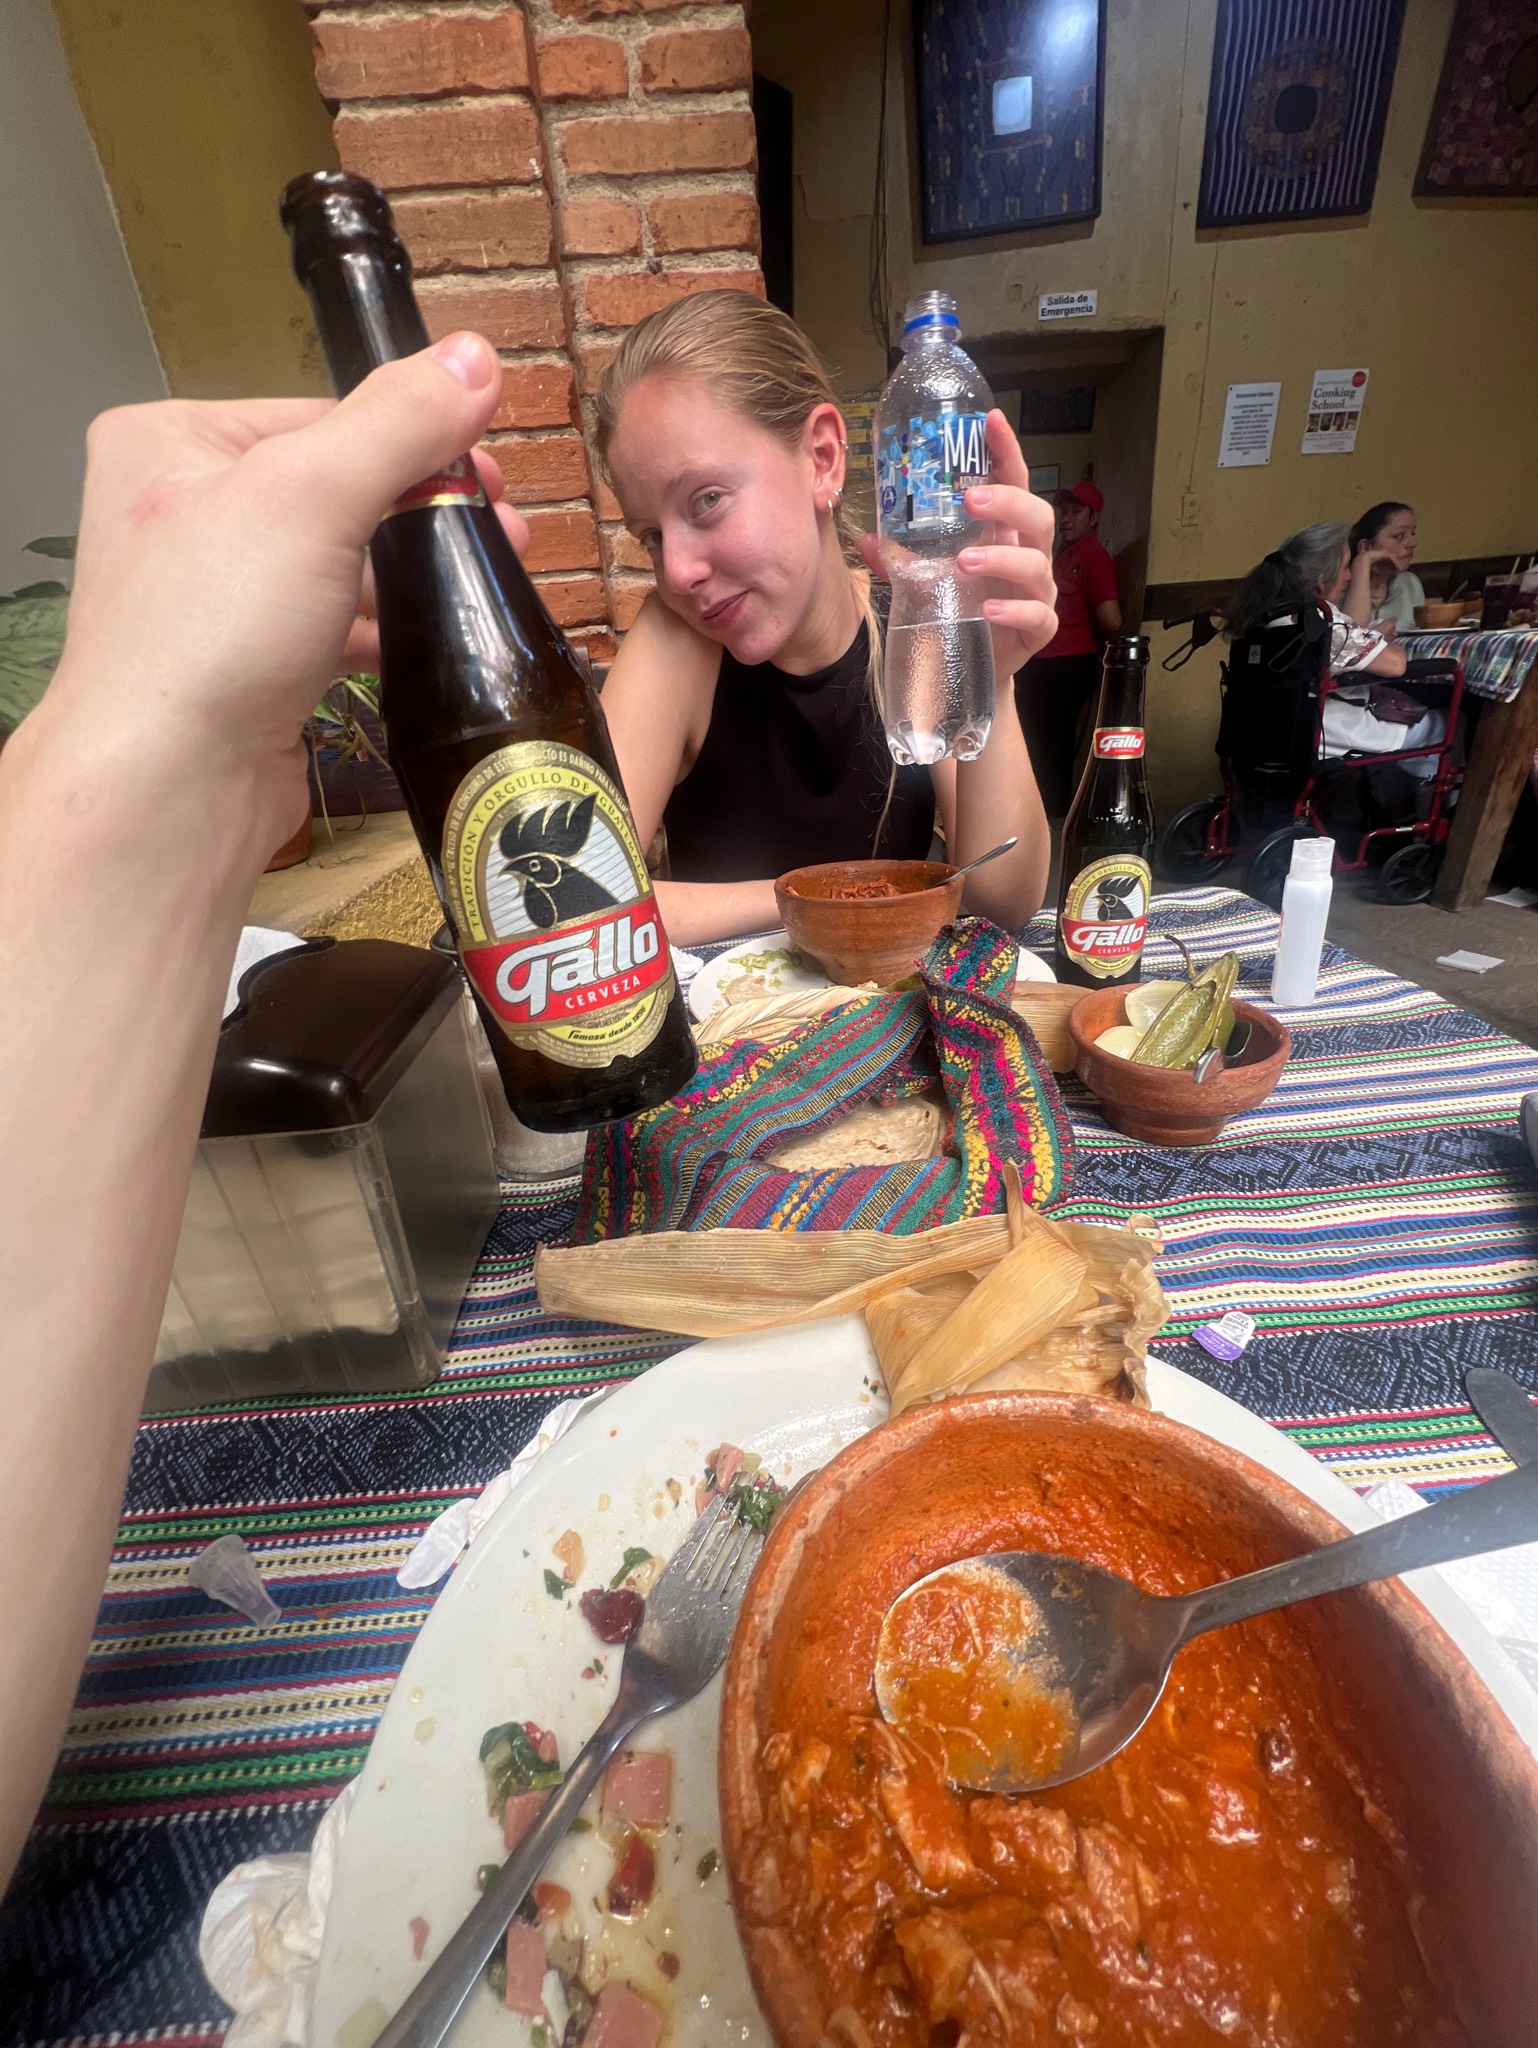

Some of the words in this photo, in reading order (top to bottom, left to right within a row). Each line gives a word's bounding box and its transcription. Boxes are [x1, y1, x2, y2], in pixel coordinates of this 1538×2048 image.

[1047, 295, 1075, 306] Salida
[1077, 294, 1088, 303] de
[1041, 304, 1093, 317] Emergencia
[1314, 387, 1356, 399] Cooking
[1311, 399, 1346, 410] School
[1100, 735, 1142, 752] Gallo
[569, 752, 594, 775] DAÑINO
[462, 831, 480, 927] TRADICIÓN
[473, 813, 484, 825] Y
[484, 772, 562, 811] ORGULLO
[570, 776, 591, 793] DE
[600, 795, 645, 881] GUATEMALA
[1071, 923, 1145, 952] Gallo
[1097, 946, 1131, 954] CERVEZA
[496, 914, 659, 1018] Gallo
[565, 975, 641, 1009] CERVEZA
[568, 1030, 607, 1041] Famosa
[608, 1021, 632, 1038] desde
